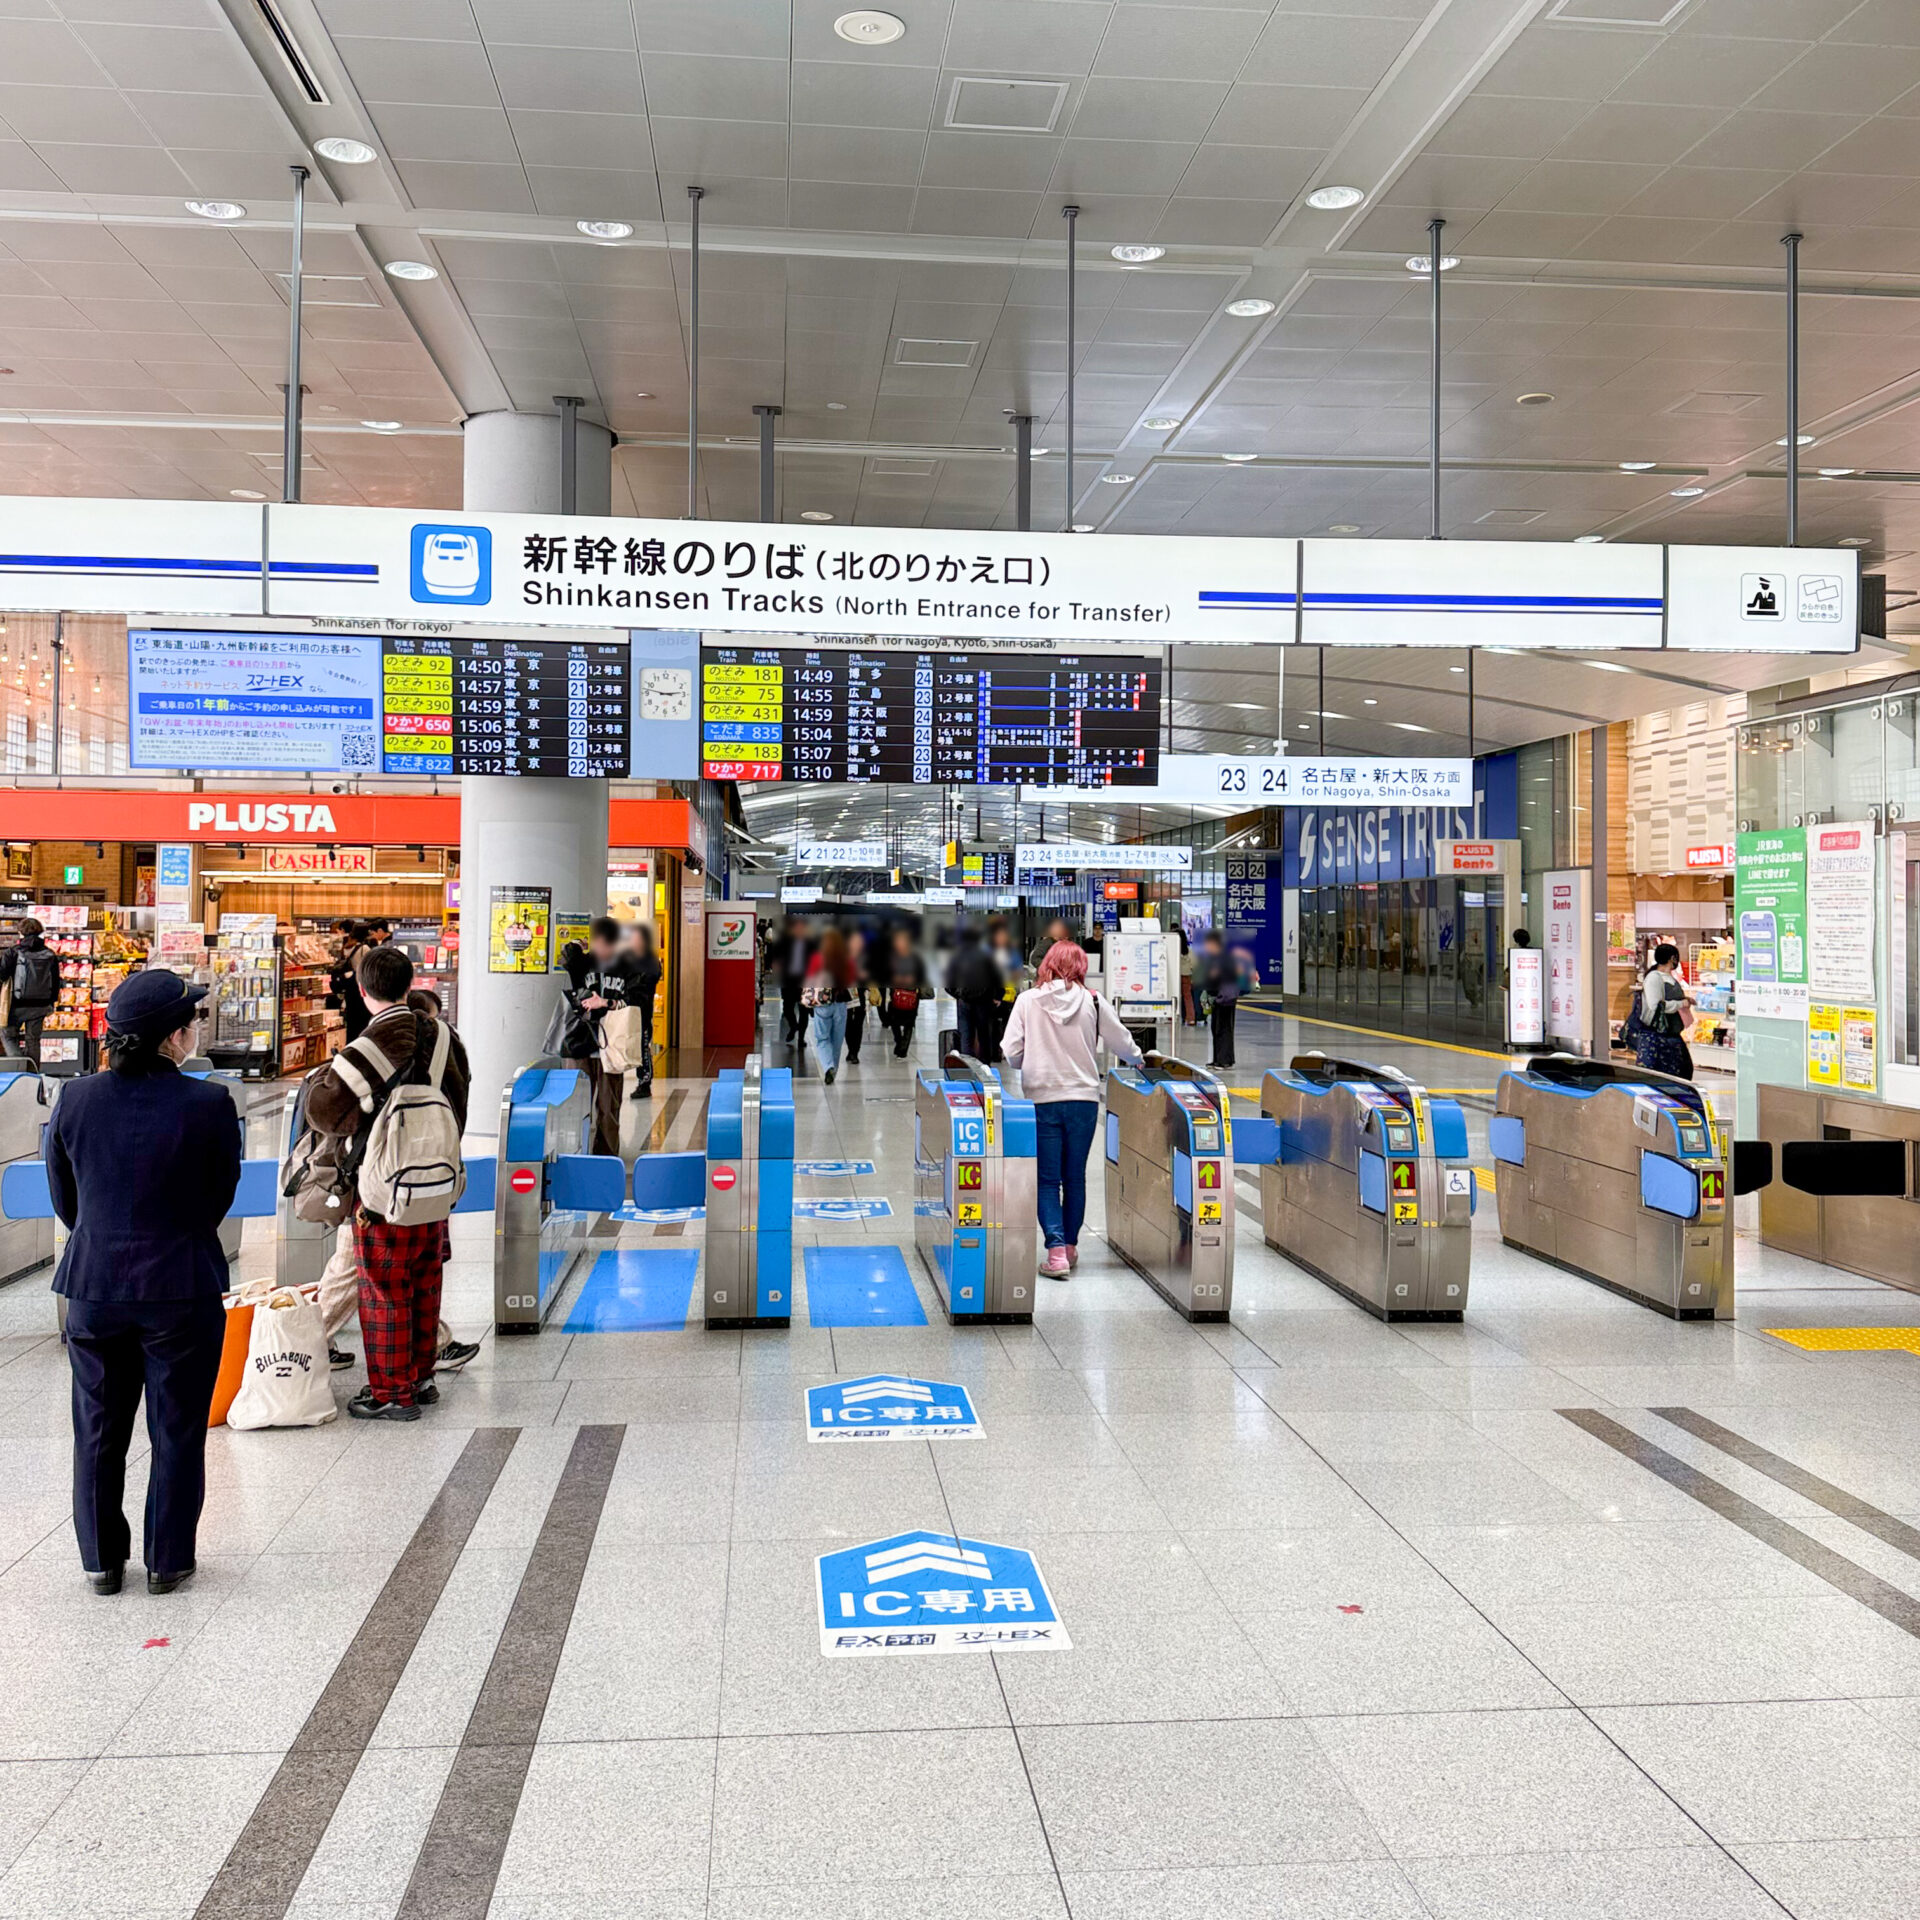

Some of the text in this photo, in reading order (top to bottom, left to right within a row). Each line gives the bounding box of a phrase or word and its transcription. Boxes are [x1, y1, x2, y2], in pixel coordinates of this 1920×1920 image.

[524, 581, 1171, 623] Shinkansen Tracks (North Entrance for Transfer)
[312, 619, 380, 629] Shinkansen
[504, 650, 543, 658] Destination
[387, 658, 423, 667] のぞみ
[429, 660, 446, 671] 92
[460, 660, 501, 674] 14:50
[570, 664, 586, 676] 22
[710, 666, 745, 676] のぞみ
[754, 669, 779, 680] 181
[793, 670, 833, 683] 14:49
[917, 672, 932, 685] 24
[246, 674, 304, 687] スマートEX
[387, 677, 423, 687] のぞみ
[427, 680, 450, 691] 136
[460, 680, 501, 694] 14:57
[570, 684, 586, 696] 21
[710, 686, 744, 695] のぞみ
[758, 688, 775, 699] 75
[793, 689, 833, 702] 14:55
[917, 692, 932, 704] 23
[387, 697, 423, 707] のぞみ
[426, 700, 450, 711] 390
[460, 700, 501, 713] 14:59
[570, 703, 586, 716] 22
[710, 705, 744, 715] のぞみ
[753, 708, 779, 719] 431
[793, 709, 833, 721] 14:59
[917, 711, 932, 724] 24
[387, 716, 423, 726] ひかり
[425, 720, 450, 731] 650
[460, 719, 501, 733] 15:06
[570, 723, 586, 736] 22
[710, 724, 744, 735] こだま
[752, 727, 779, 739] 835
[792, 728, 832, 741] 15:04
[917, 730, 930, 743] 24
[387, 738, 424, 748] のぞみ
[430, 740, 446, 751] 20
[460, 739, 501, 753] 15:09
[570, 743, 586, 755] 21
[710, 744, 744, 754] のぞみ
[754, 747, 779, 758] 183
[792, 747, 832, 760] 15:07
[917, 749, 930, 762] 23
[388, 757, 423, 766] こだま
[426, 760, 450, 770] 822
[460, 759, 501, 772] 15:12
[570, 762, 586, 775] 22
[710, 763, 744, 774] ひかり
[752, 765, 779, 778] 717
[792, 766, 832, 779] 15:10
[917, 768, 930, 781] 24
[1221, 768, 1460, 792] 23 24 名古屋・新大阪 方面
[1302, 786, 1318, 796] for
[1324, 786, 1374, 799] Nagoya,
[189, 802, 336, 832] PLUSTA
[1321, 808, 1391, 868] SENSE
[817, 848, 827, 859] 21
[833, 848, 845, 859] 22
[1023, 850, 1034, 861] 23
[1040, 850, 1050, 861] 24
[1456, 846, 1491, 854] PLUSTA
[1688, 848, 1722, 866] PLUSTA
[269, 853, 368, 870] CASHIER
[1230, 864, 1264, 877] 23 24
[1454, 858, 1494, 868] Bento
[1228, 884, 1266, 896] 名古屋
[1228, 898, 1266, 910] 新大阪
[1553, 900, 1571, 910] Bento
[959, 1122, 979, 1140] IC
[959, 1142, 980, 1152] 専用
[959, 1166, 981, 1186] IC
[255, 1352, 312, 1373] BILLABONG
[822, 1406, 964, 1422] IC専用
[839, 1588, 1036, 1617] IC専用
[955, 1629, 1052, 1640] スマートEX
